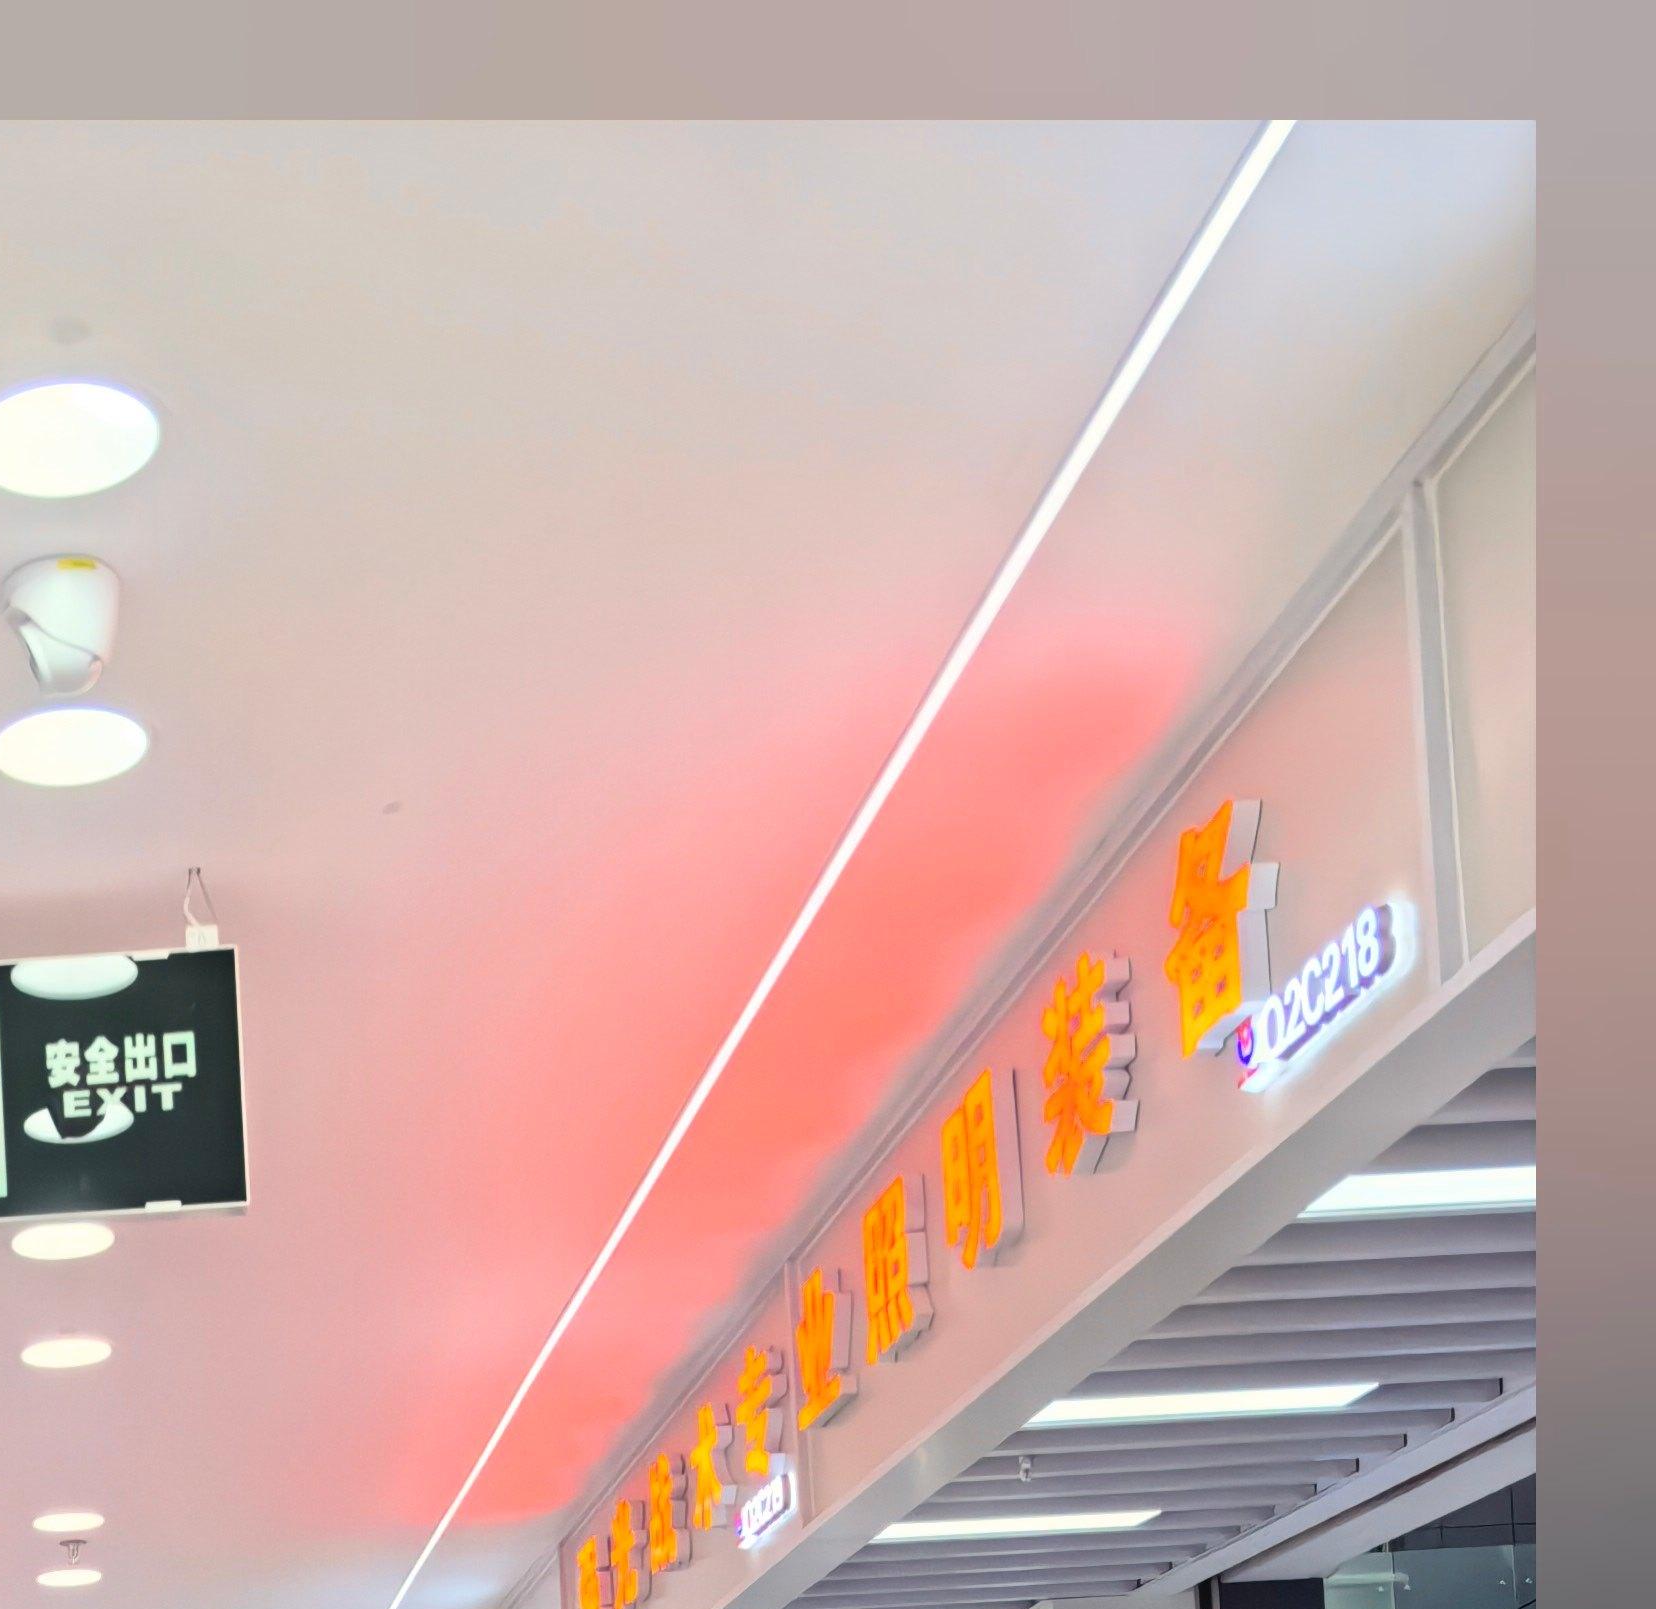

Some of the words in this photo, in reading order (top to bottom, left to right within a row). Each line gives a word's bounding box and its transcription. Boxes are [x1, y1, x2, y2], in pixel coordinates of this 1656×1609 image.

[45, 1030, 197, 1089] 安全出口
[62, 1082, 183, 1119] EXIT
